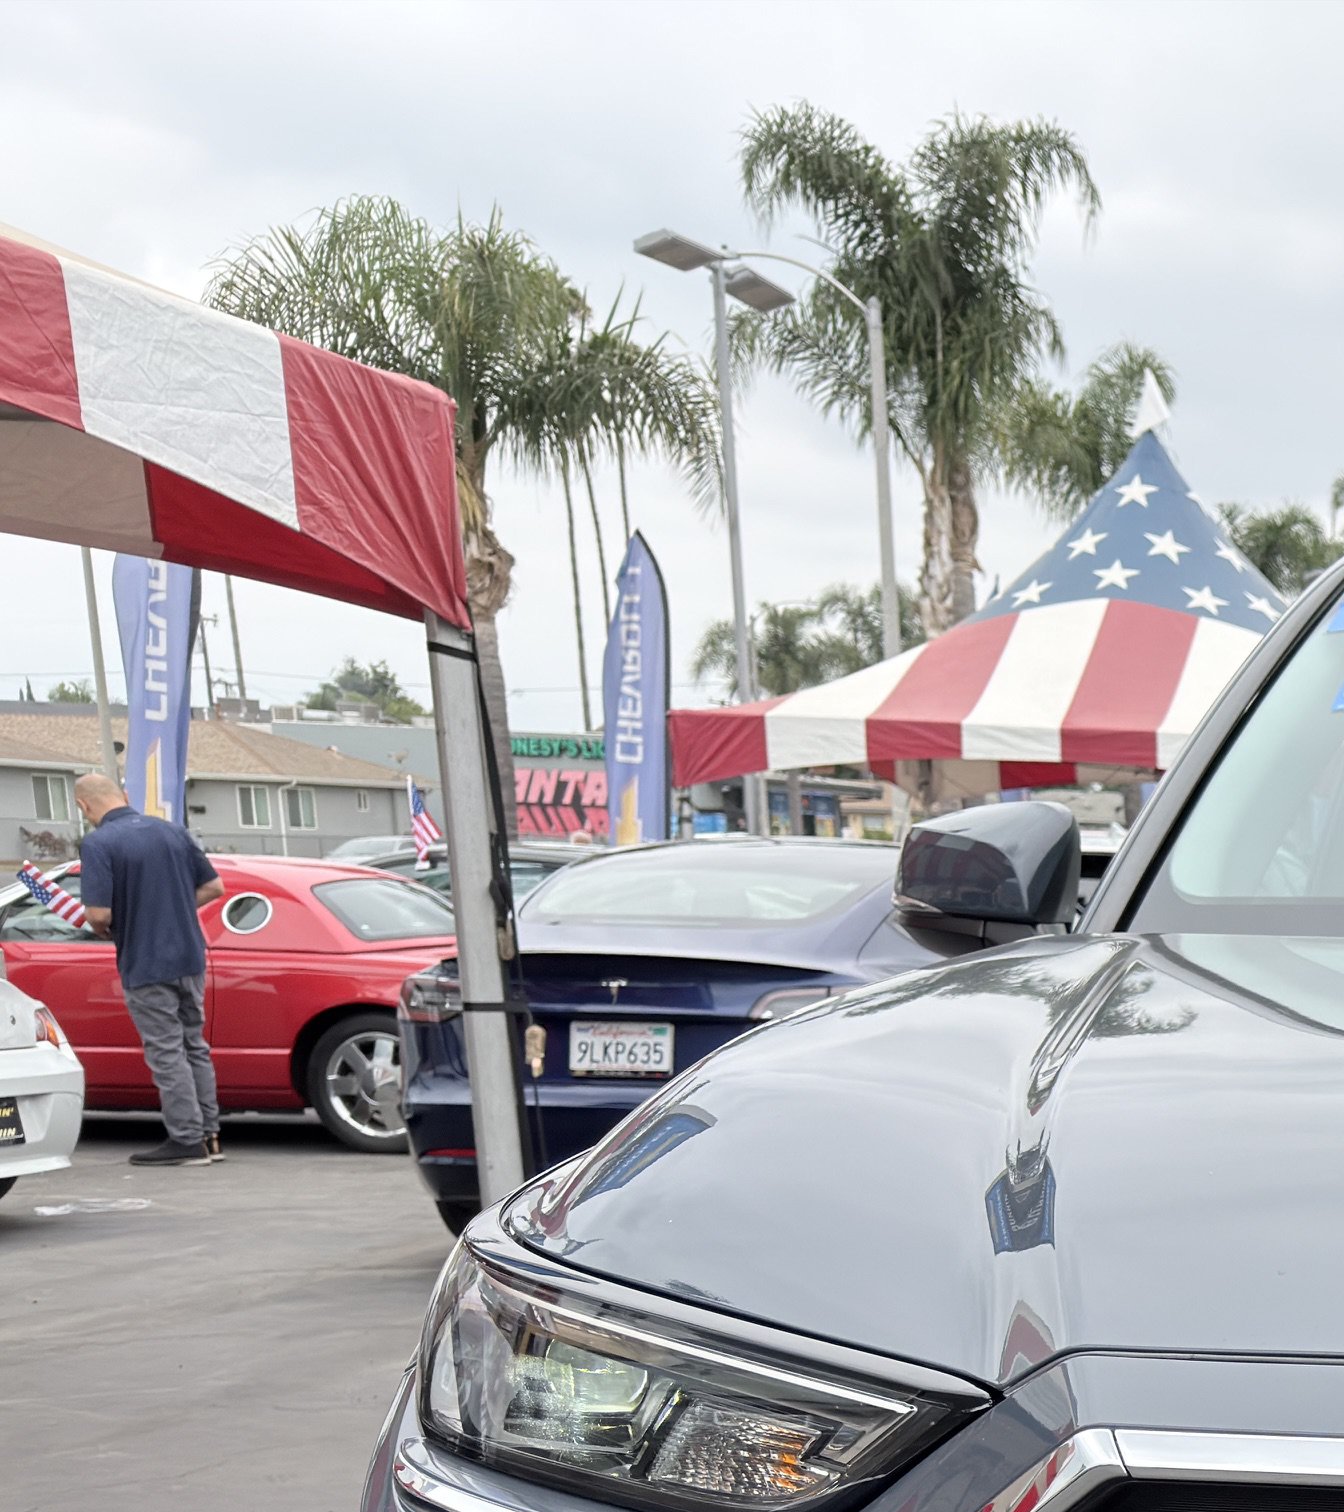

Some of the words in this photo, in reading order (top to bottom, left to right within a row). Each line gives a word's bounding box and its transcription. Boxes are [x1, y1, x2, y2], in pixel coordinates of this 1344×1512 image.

[511, 736, 578, 758] NESY'S
[514, 768, 608, 806] ANTA
[577, 1040, 665, 1066] 9LKP635
